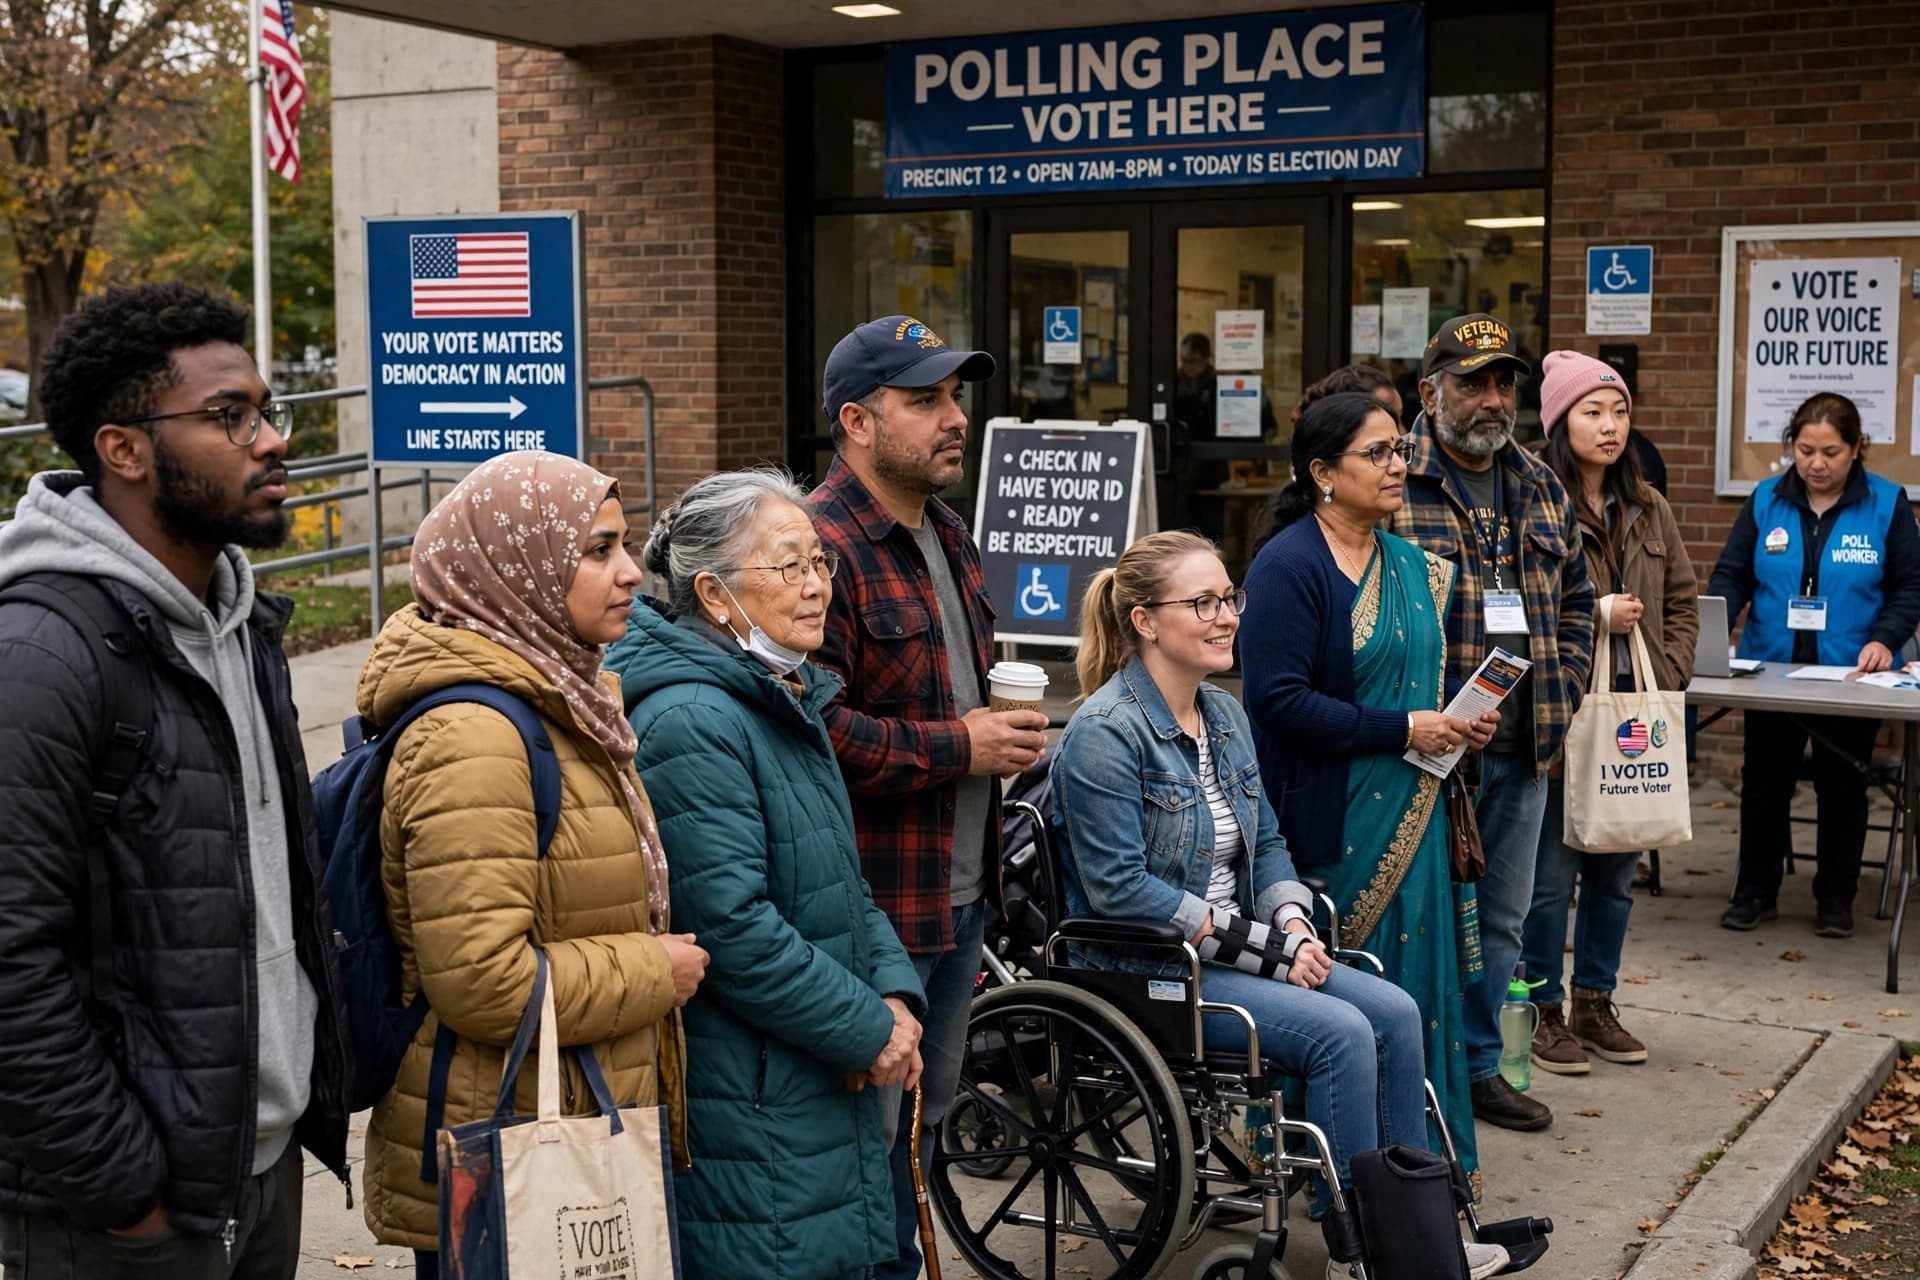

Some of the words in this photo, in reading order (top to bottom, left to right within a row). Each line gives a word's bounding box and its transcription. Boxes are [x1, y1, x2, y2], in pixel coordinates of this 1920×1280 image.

[914, 37, 1162, 104] POLLING
[1184, 21, 1384, 85] PLACE
[1022, 101, 1132, 142] VOTE
[1148, 93, 1264, 136] HERE
[903, 167, 983, 187] PRECINCT
[989, 165, 1006, 184] 12
[1027, 163, 1073, 182] OPEN
[1183, 155, 1242, 175] TODAY
[1248, 154, 1263, 173] IS
[1269, 149, 1358, 172] ELECTION
[1365, 147, 1402, 168] DAY
[1792, 271, 1857, 299] VOTE
[1765, 308, 1808, 332] OUR
[1816, 307, 1881, 332] VOICE
[382, 332, 429, 353] YOUR
[433, 332, 478, 353] VOTE
[483, 331, 563, 353] MATTERS
[1454, 320, 1509, 343] VETERAN
[1756, 341, 1798, 366] OUR
[1807, 341, 1888, 365] FUTURE
[383, 364, 480, 384] DEMOCRACY
[485, 364, 500, 384] IN
[505, 364, 565, 384] ACTION
[407, 430, 440, 449] LINE
[444, 430, 500, 449] STARTS
[505, 430, 545, 450] HERE
[1020, 450, 1077, 471] CHECK
[1082, 452, 1101, 472] IN
[999, 477, 1046, 498] HAVE
[1051, 478, 1099, 500] YOUR
[1104, 480, 1123, 501] ID
[1023, 505, 1083, 527] READY
[988, 531, 1010, 552] BE
[1014, 533, 1116, 557] RESPECTFUL
[1842, 535, 1871, 548] POLL
[1832, 549, 1877, 563] WORKER
[1601, 764, 1606, 780] I
[1612, 762, 1668, 779] VOTED
[1599, 783, 1639, 795] Future
[1642, 782, 1671, 793] Voter
[569, 1215, 626, 1259] VOTE
